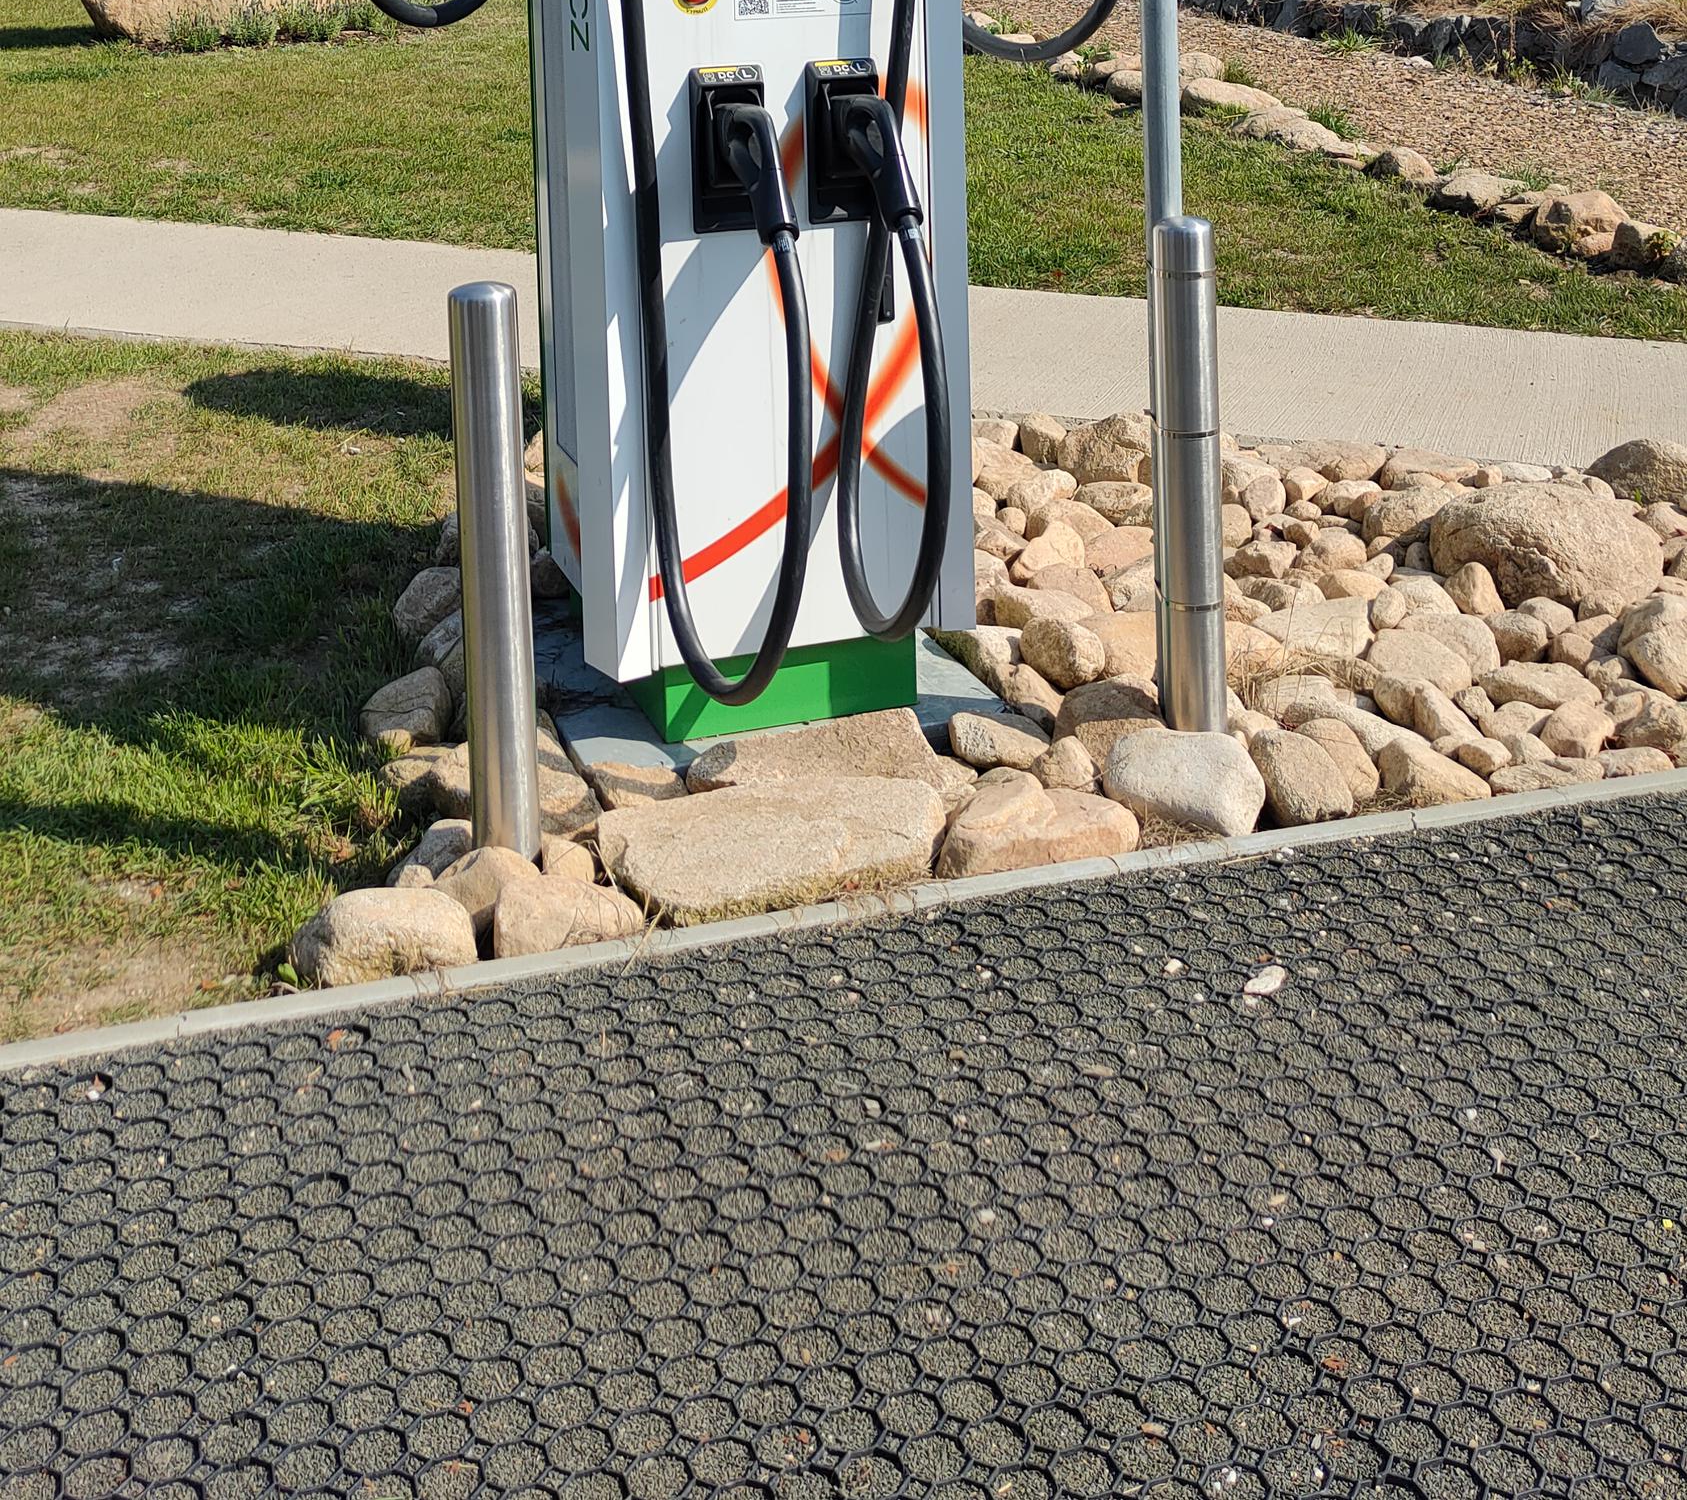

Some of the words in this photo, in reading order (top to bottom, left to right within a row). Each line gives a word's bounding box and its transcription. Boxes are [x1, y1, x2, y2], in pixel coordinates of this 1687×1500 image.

[718, 71, 735, 79] DC
[741, 68, 752, 78] L
[833, 65, 850, 73] DC
